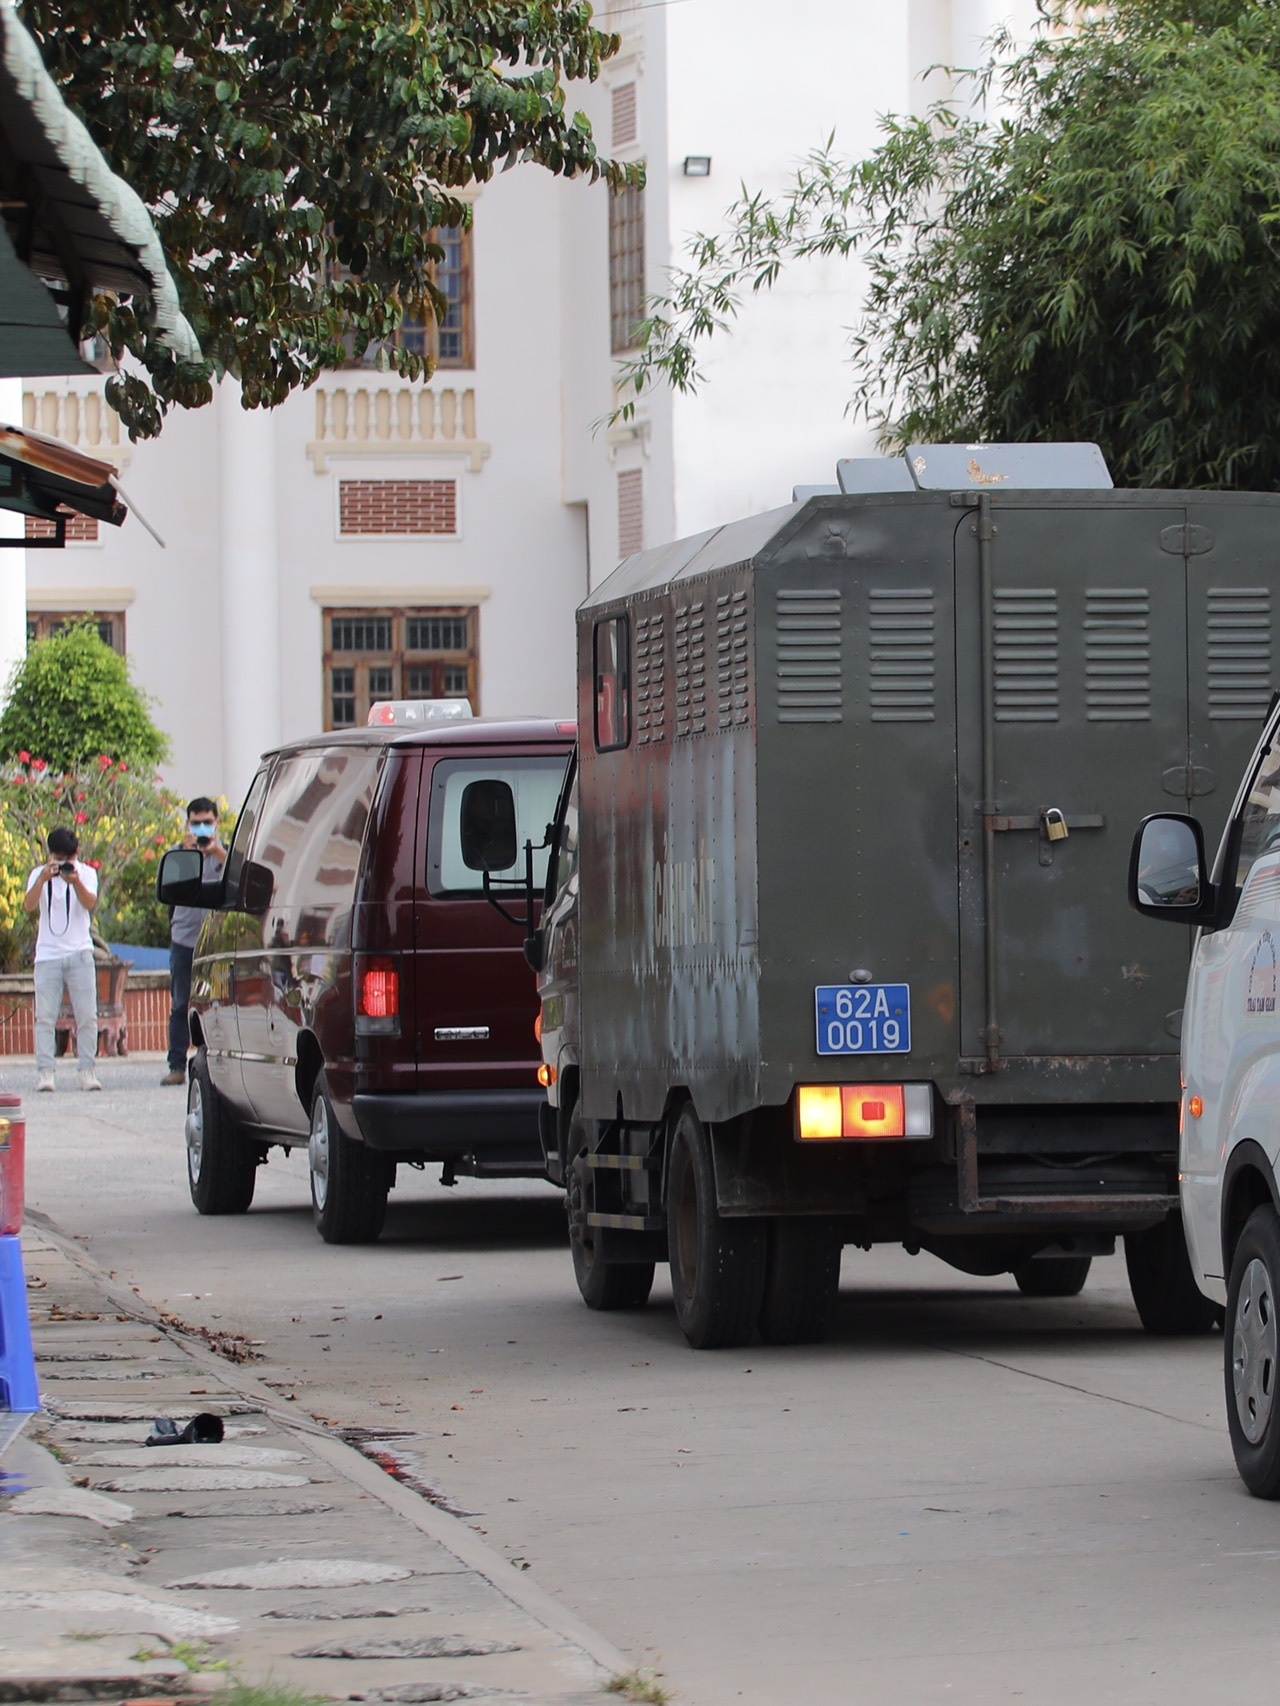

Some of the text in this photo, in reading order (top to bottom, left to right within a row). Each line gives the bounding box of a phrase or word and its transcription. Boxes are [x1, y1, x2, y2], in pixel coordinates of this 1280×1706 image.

[655, 831, 688, 948] CẢNH
[691, 838, 715, 944] SÁT
[835, 988, 890, 1019] 62A
[827, 1020, 900, 1050] 0019
